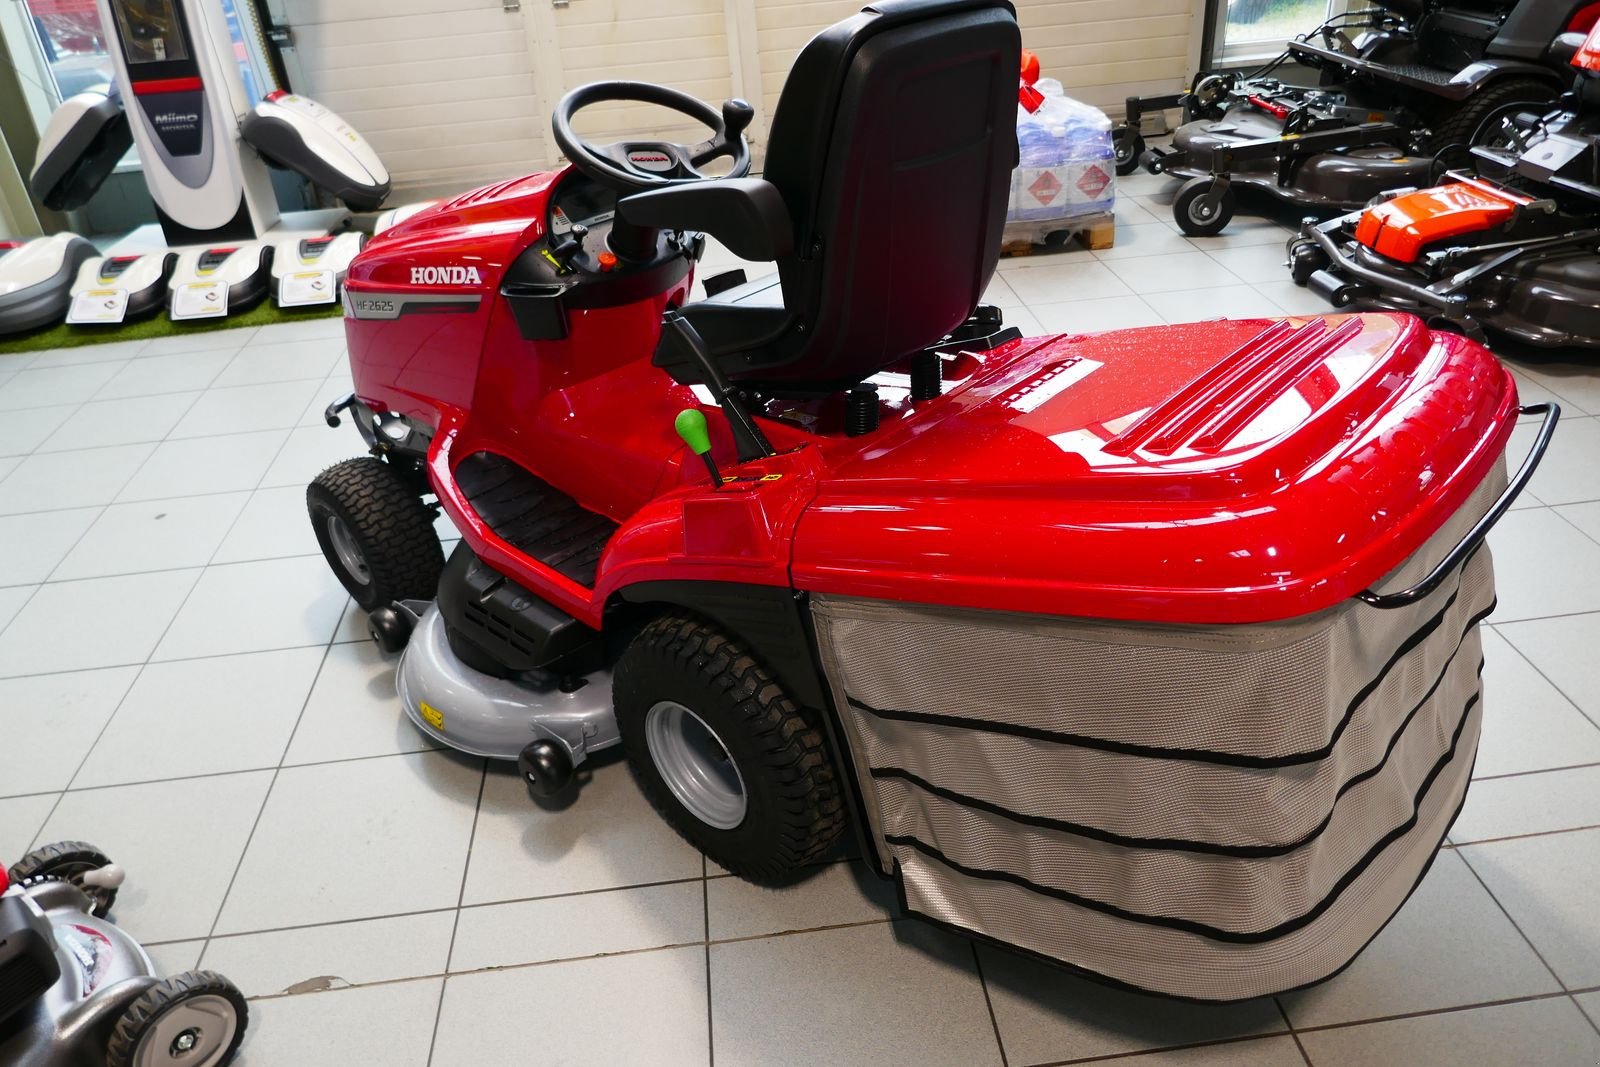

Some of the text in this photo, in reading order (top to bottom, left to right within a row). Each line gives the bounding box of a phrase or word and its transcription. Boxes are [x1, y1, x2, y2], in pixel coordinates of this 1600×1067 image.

[155, 112, 198, 123] Miimo
[410, 266, 482, 285] HONDA
[368, 300, 394, 312] 2625
